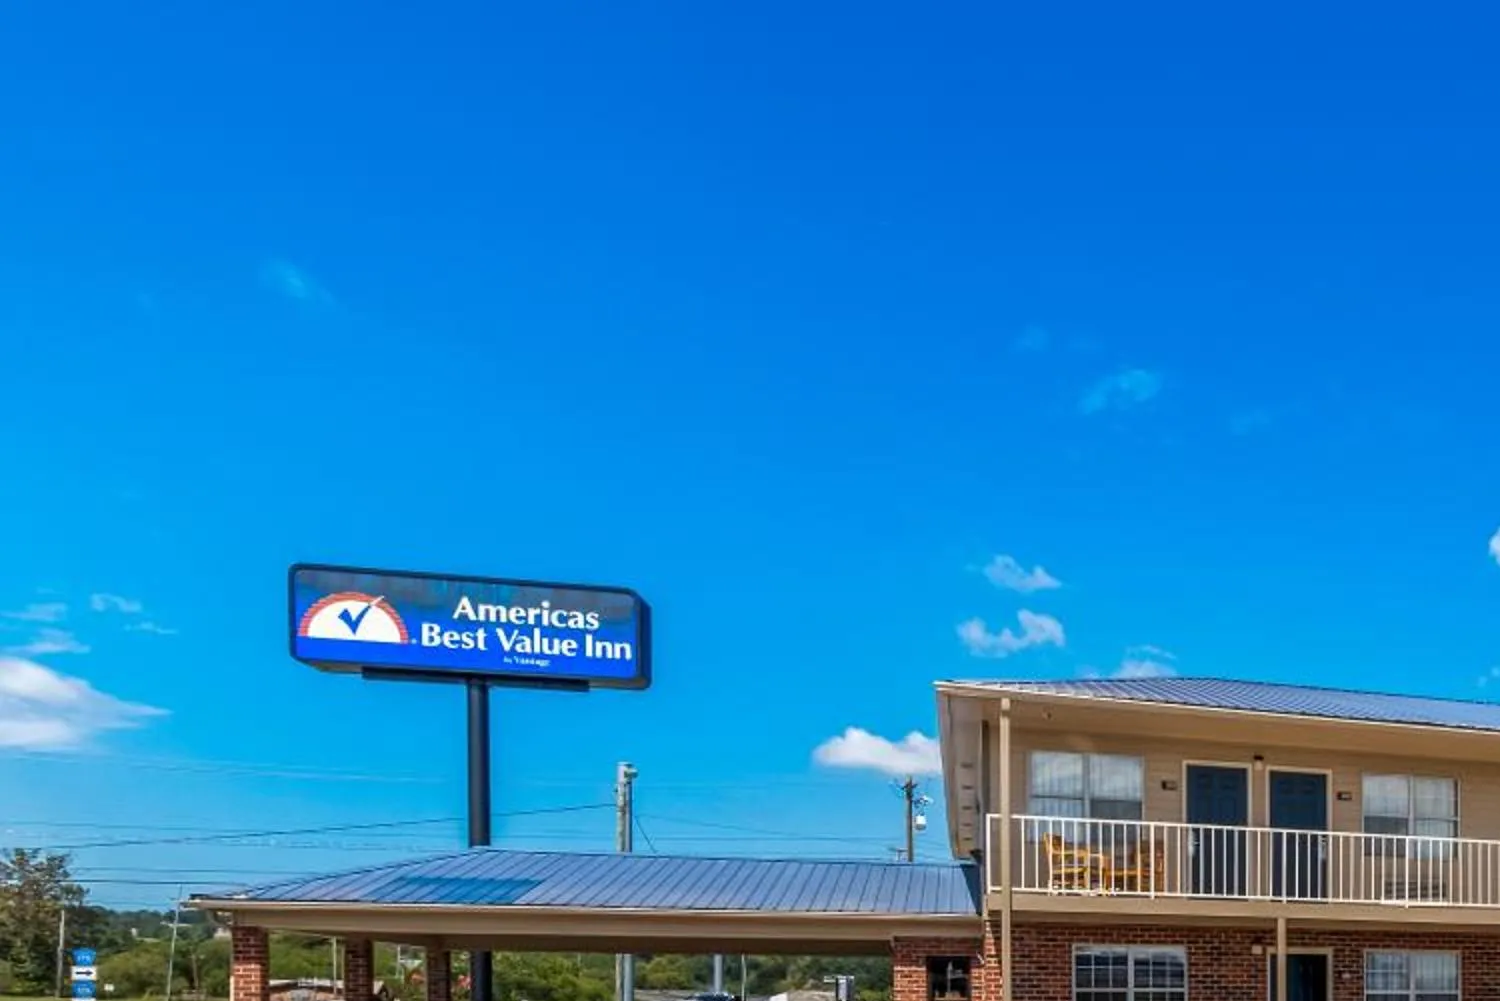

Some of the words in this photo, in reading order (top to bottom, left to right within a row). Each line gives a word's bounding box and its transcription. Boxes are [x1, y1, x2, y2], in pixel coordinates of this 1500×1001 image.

[453, 596, 600, 630] Americas
[421, 623, 487, 651] Best
[496, 627, 577, 656] Value
[585, 633, 633, 660] Inn
